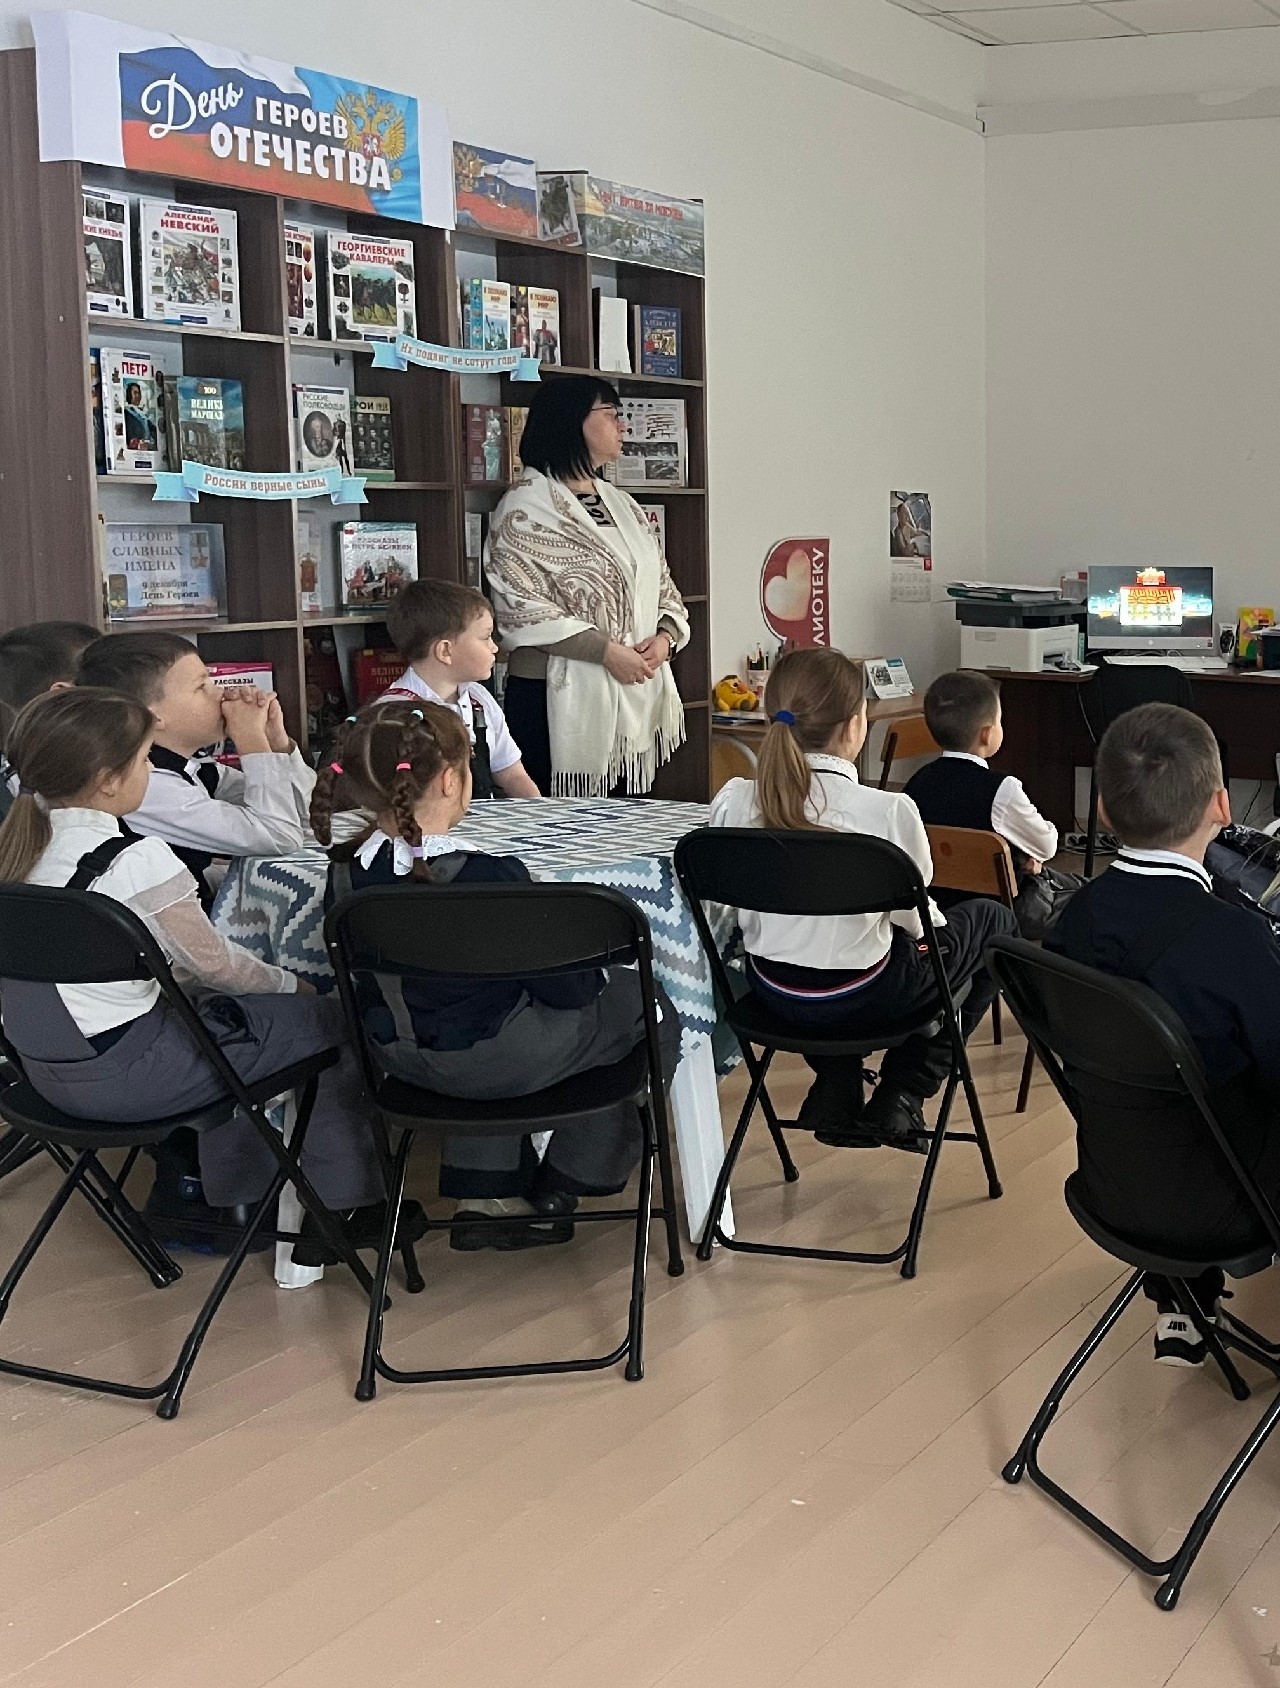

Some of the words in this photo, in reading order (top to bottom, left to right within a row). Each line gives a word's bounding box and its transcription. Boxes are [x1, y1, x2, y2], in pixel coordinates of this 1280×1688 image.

[141, 72, 244, 139] День
[255, 96, 349, 140] ГЕРОЕВ
[210, 121, 392, 192] ОТЕЧЕСТВА
[164, 211, 216, 223] АЛЕКСАНДР
[160, 218, 220, 235] НЕВСКИЙ
[337, 241, 406, 258] ГЕОРГИЕВСКИЕ
[349, 253, 395, 266] КАВАЛЕРЫ
[416, 349, 449, 364] подвиг
[452, 356, 463, 366] не
[464, 358, 495, 370] сотрут
[497, 355, 518, 366] года
[121, 361, 148, 377] ПЕТР
[203, 386, 217, 395] 100
[302, 392, 329, 401] РУССКИЕ
[204, 473, 248, 490] России
[250, 480, 293, 494] верные
[296, 476, 326, 490] сыны
[122, 531, 174, 542] ГЕРОЕВ
[112, 546, 183, 557] СЛАВНЫХ
[125, 560, 177, 572] ИМЕНА
[140, 591, 165, 600] День
[166, 590, 200, 600] Героев
[812, 547, 826, 646] ЛИОТЕКУ
